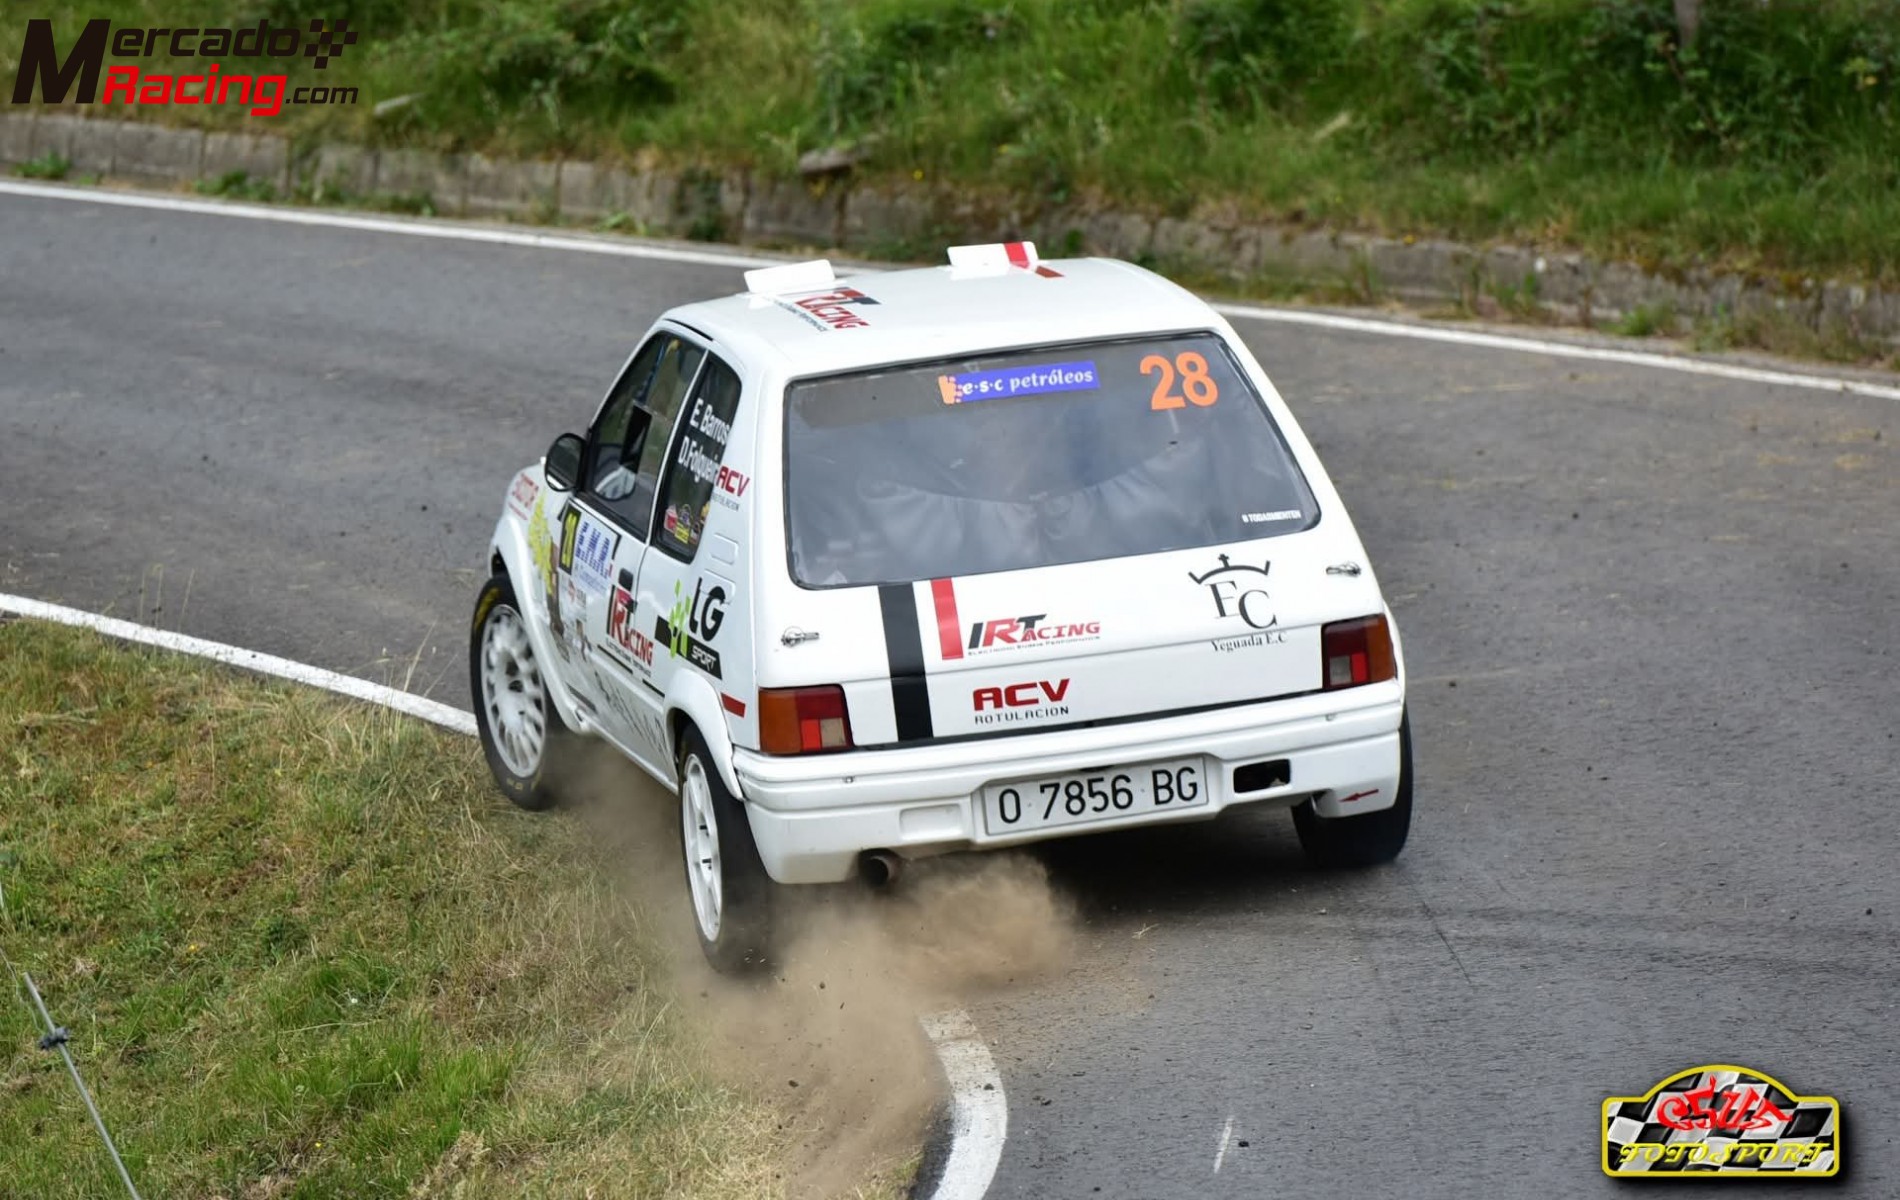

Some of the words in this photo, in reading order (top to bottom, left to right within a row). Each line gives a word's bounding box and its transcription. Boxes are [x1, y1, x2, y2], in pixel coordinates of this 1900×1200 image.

[1009, 368, 1094, 392] petróleos
[1139, 351, 1219, 410] 28
[689, 576, 726, 642] LG
[691, 644, 717, 672] SPORT
[1211, 634, 1263, 653] Yeguada
[973, 677, 1071, 711] ACV
[1039, 774, 1134, 821] 7856
[1152, 765, 1199, 806] BG
